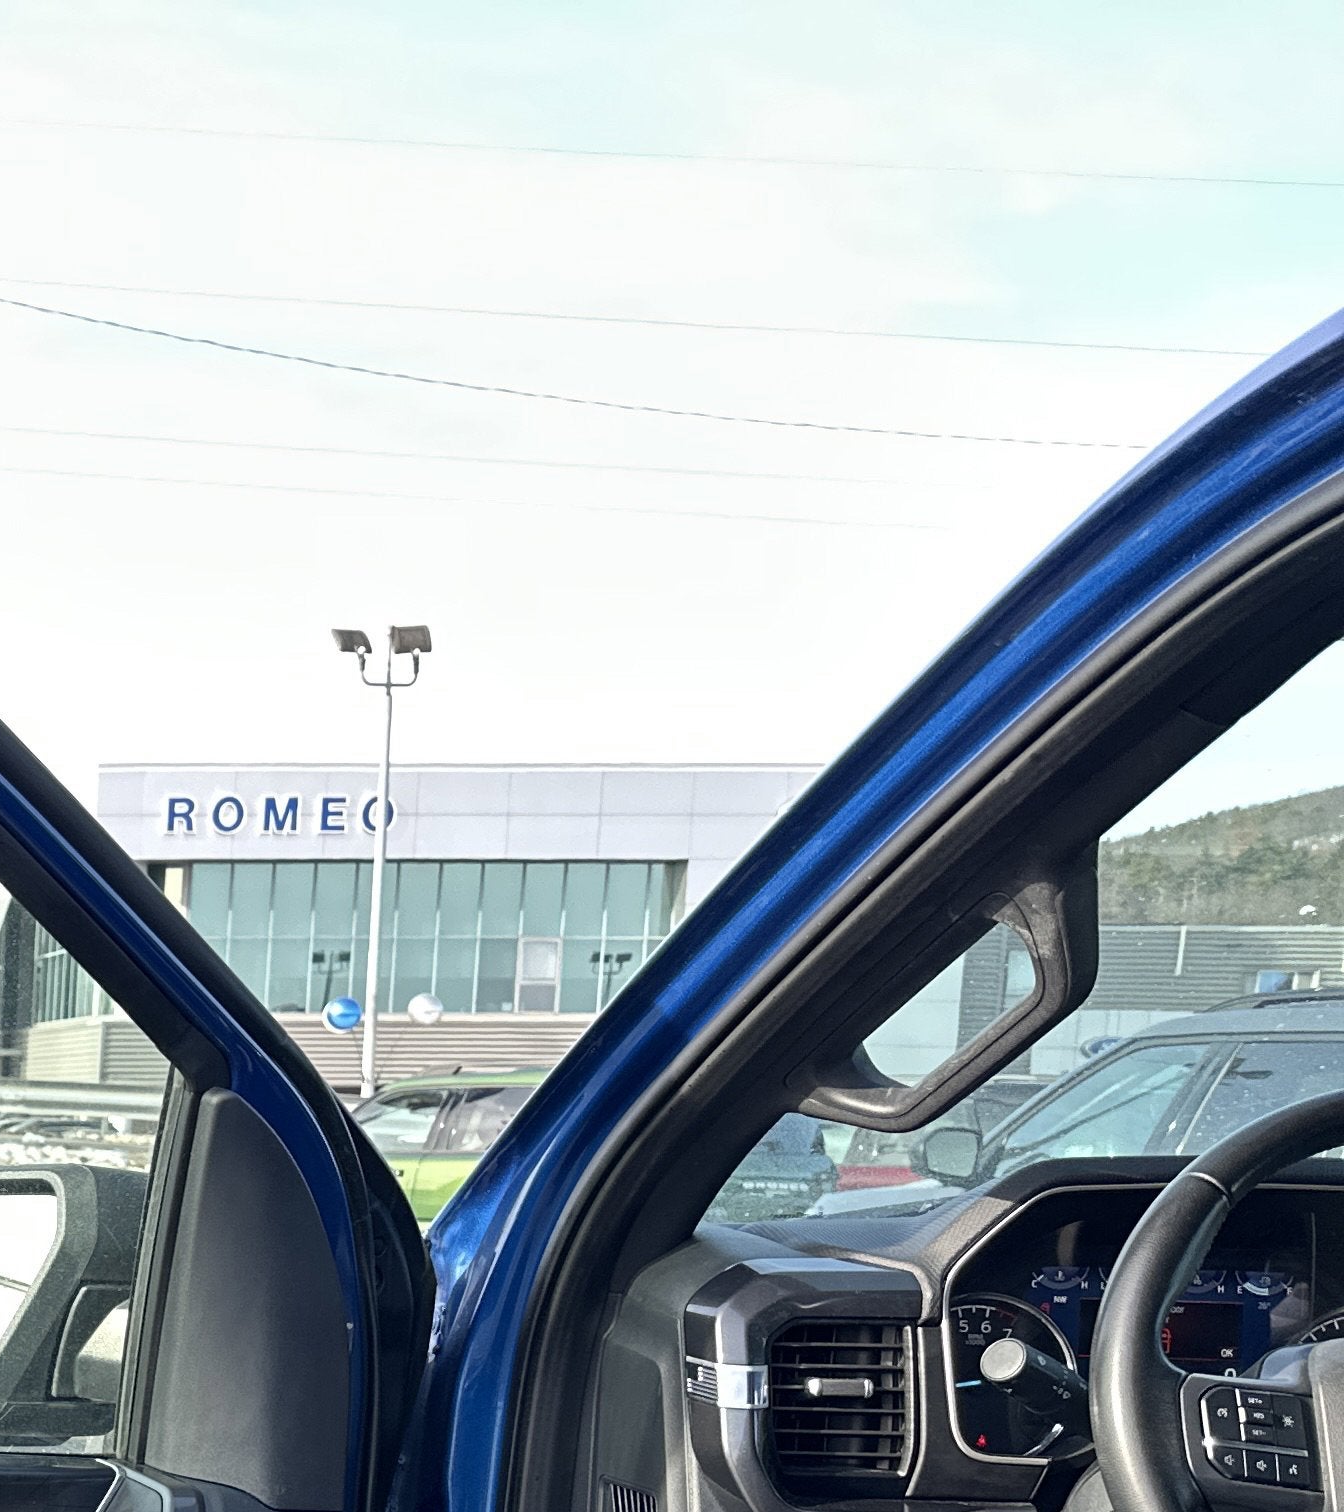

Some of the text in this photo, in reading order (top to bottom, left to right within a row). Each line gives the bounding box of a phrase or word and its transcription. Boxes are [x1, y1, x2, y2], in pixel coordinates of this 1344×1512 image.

[166, 796, 395, 832] ROMEO
[958, 1320, 969, 1333] 5
[980, 1320, 992, 1333] 6
[1220, 1348, 1234, 1358] OK
